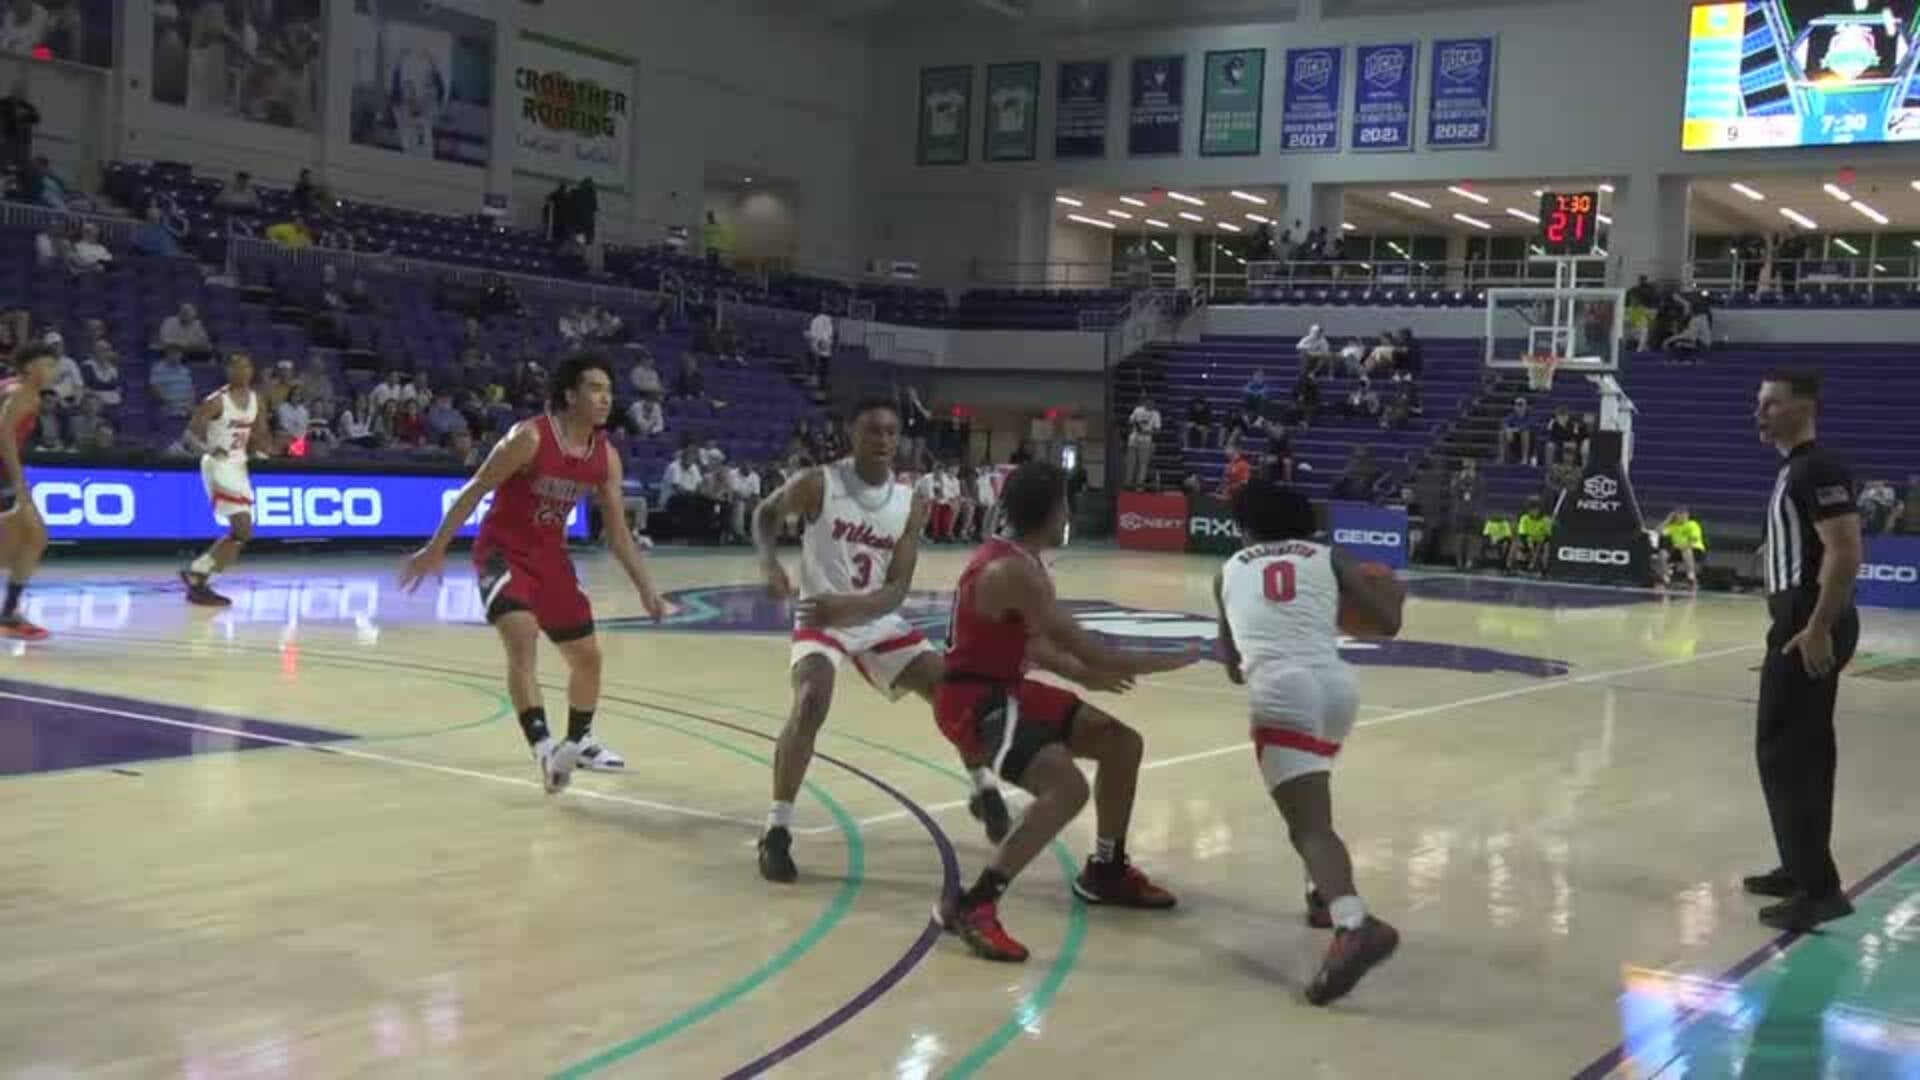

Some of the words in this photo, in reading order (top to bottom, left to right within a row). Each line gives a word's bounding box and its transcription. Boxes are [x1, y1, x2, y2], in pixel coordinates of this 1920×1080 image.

[515, 67, 627, 116] CROWTHER
[521, 97, 616, 138] ROOFING
[1821, 114, 1867, 132] 7:30
[1289, 133, 1328, 146] 2017
[1360, 128, 1399, 142] 2021
[1435, 123, 1480, 139] 2022
[1727, 125, 1739, 141] 9
[1548, 211, 1584, 242] 21
[214, 486, 383, 527] EICO
[1577, 499, 1621, 512] NEXT
[1144, 517, 1184, 530] NEXT
[1333, 528, 1401, 546] GEICO
[1557, 547, 1631, 565] GEICO
[852, 553, 872, 589] 3
[1856, 563, 1917, 582] EICO
[1262, 559, 1297, 603] 0
